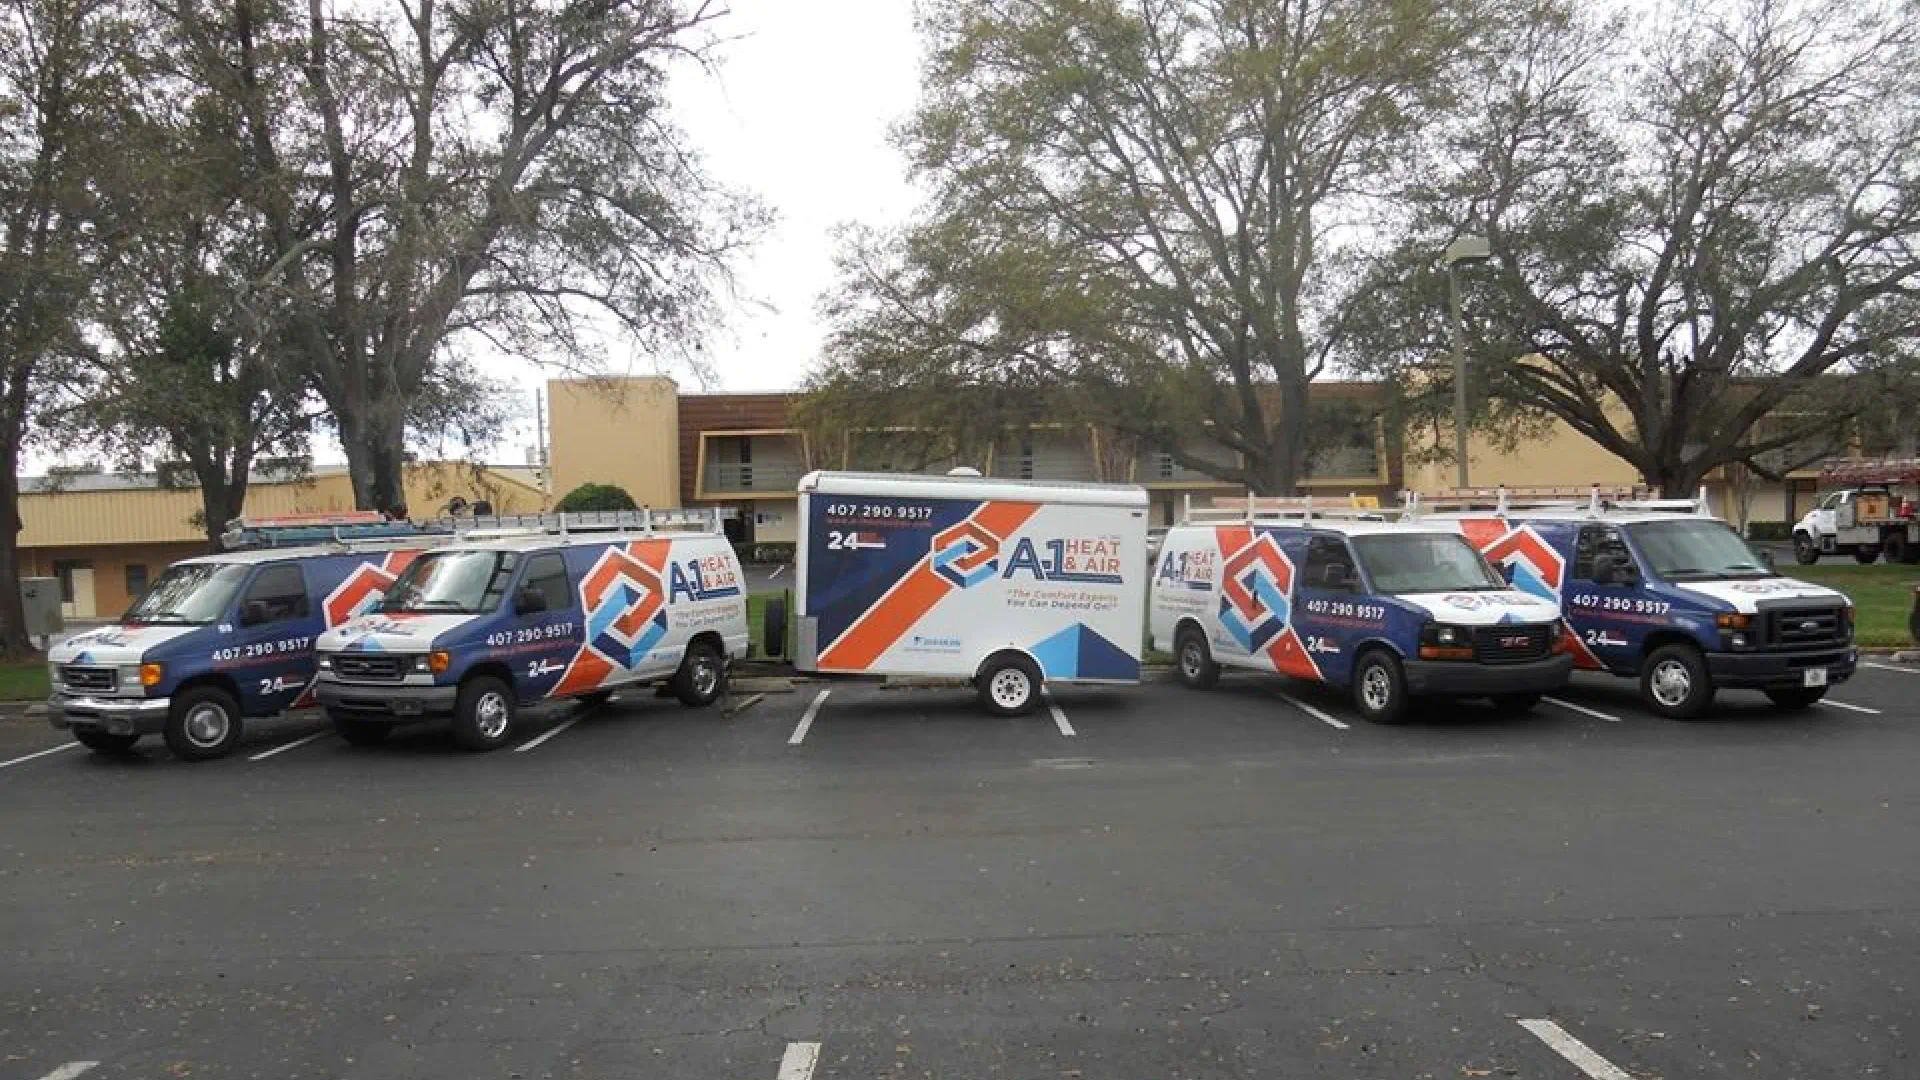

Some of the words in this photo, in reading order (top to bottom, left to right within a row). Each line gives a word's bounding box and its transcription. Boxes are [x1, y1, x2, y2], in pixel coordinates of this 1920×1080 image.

[827, 504, 857, 516] 407
[863, 504, 893, 518] 290
[897, 506, 933, 520] 9517
[827, 530, 858, 550] 24
[1065, 538, 1121, 556] HEAT
[701, 555, 730, 572] HEAT
[1065, 556, 1077, 570] &
[1085, 557, 1121, 574] AIR
[716, 571, 737, 587] AIR
[1307, 600, 1329, 614] 407
[1572, 594, 1599, 608] 407
[486, 630, 513, 646] 407
[517, 627, 543, 642] 290
[545, 622, 573, 638] 9517
[1585, 628, 1608, 646] 24
[1307, 634, 1325, 654] 24
[212, 646, 241, 661] 407
[528, 658, 549, 678] 24
[259, 676, 284, 695] 24
